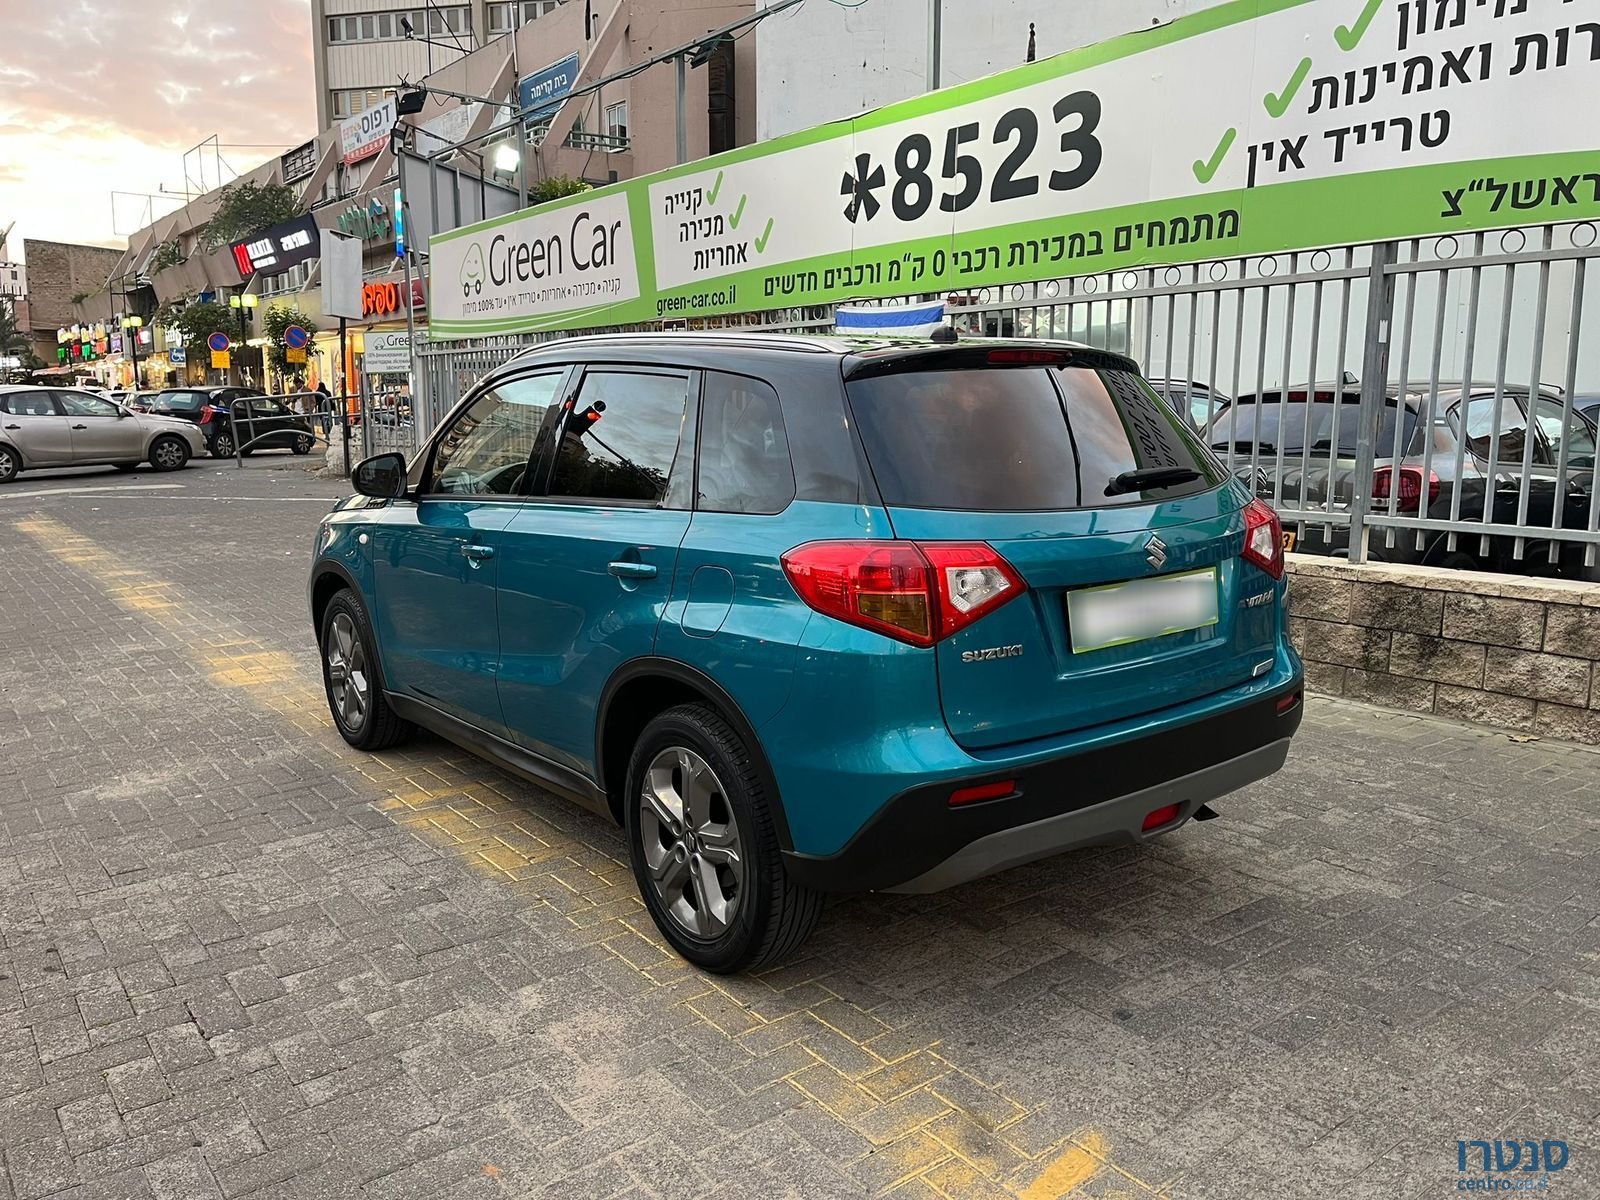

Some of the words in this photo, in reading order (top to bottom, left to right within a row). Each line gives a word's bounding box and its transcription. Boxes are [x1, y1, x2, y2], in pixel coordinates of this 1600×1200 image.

[1398, 0, 1528, 51] מון
[553, 73, 568, 89] בית
[1307, 42, 1492, 114] ואמינות
[361, 104, 390, 134] דפוס
[1324, 109, 1450, 163] טרייד
[1246, 134, 1308, 188] אין
[664, 187, 703, 216] קנייה
[679, 214, 724, 243] מכירה
[1113, 209, 1240, 253] מתמחים
[489, 234, 563, 287] Green
[570, 211, 622, 271] Car
[693, 242, 748, 271] אחריות
[952, 246, 1001, 274] רכבי
[1007, 229, 1103, 267] במכירת
[824, 262, 881, 290] ורכבים
[932, 249, 946, 277] 0
[541, 286, 567, 302] אחריות
[572, 281, 596, 297] מכירה
[602, 277, 621, 295] קניה
[764, 271, 818, 297] חדשים
[478, 299, 494, 312] 100%
[656, 284, 737, 316] green-car.co.il
[386, 334, 410, 346] Gree
[962, 643, 1024, 664] SUZUKI
